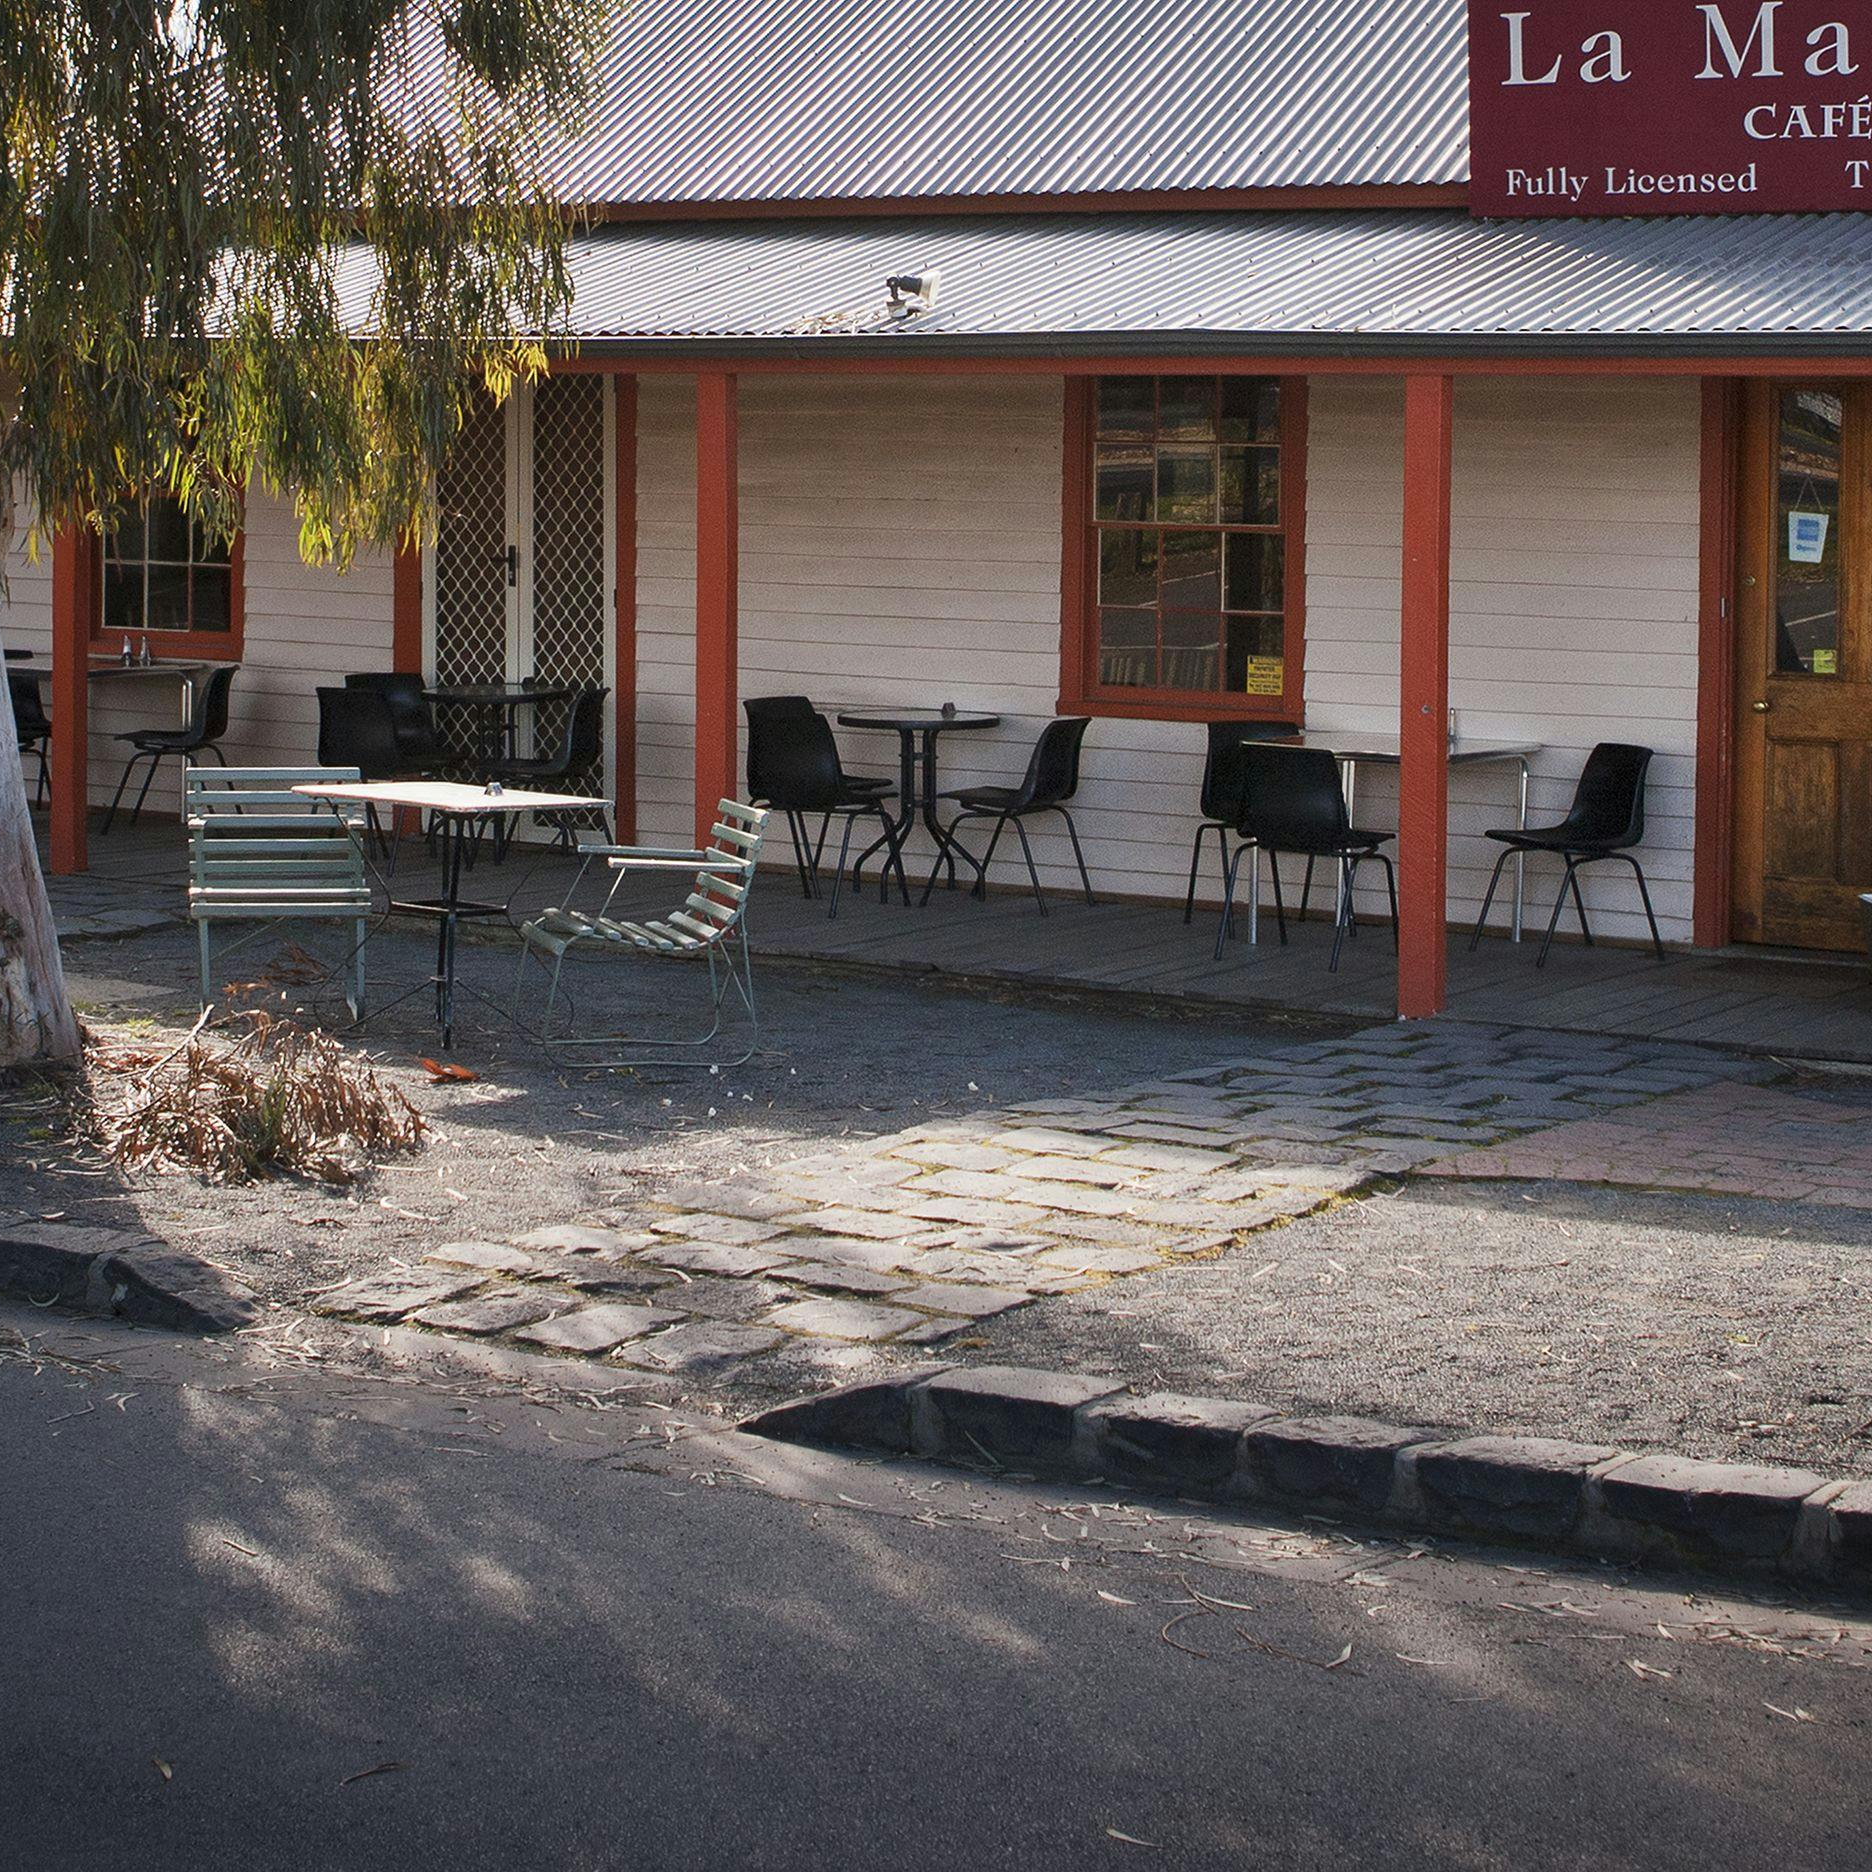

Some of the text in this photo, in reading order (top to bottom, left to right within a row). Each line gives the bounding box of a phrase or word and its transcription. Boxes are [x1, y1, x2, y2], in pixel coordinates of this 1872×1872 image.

[1499, 10, 1633, 87] La
[1505, 165, 1589, 203] Fully
[1604, 161, 1759, 195] Licensed
[1843, 159, 1871, 190] T
